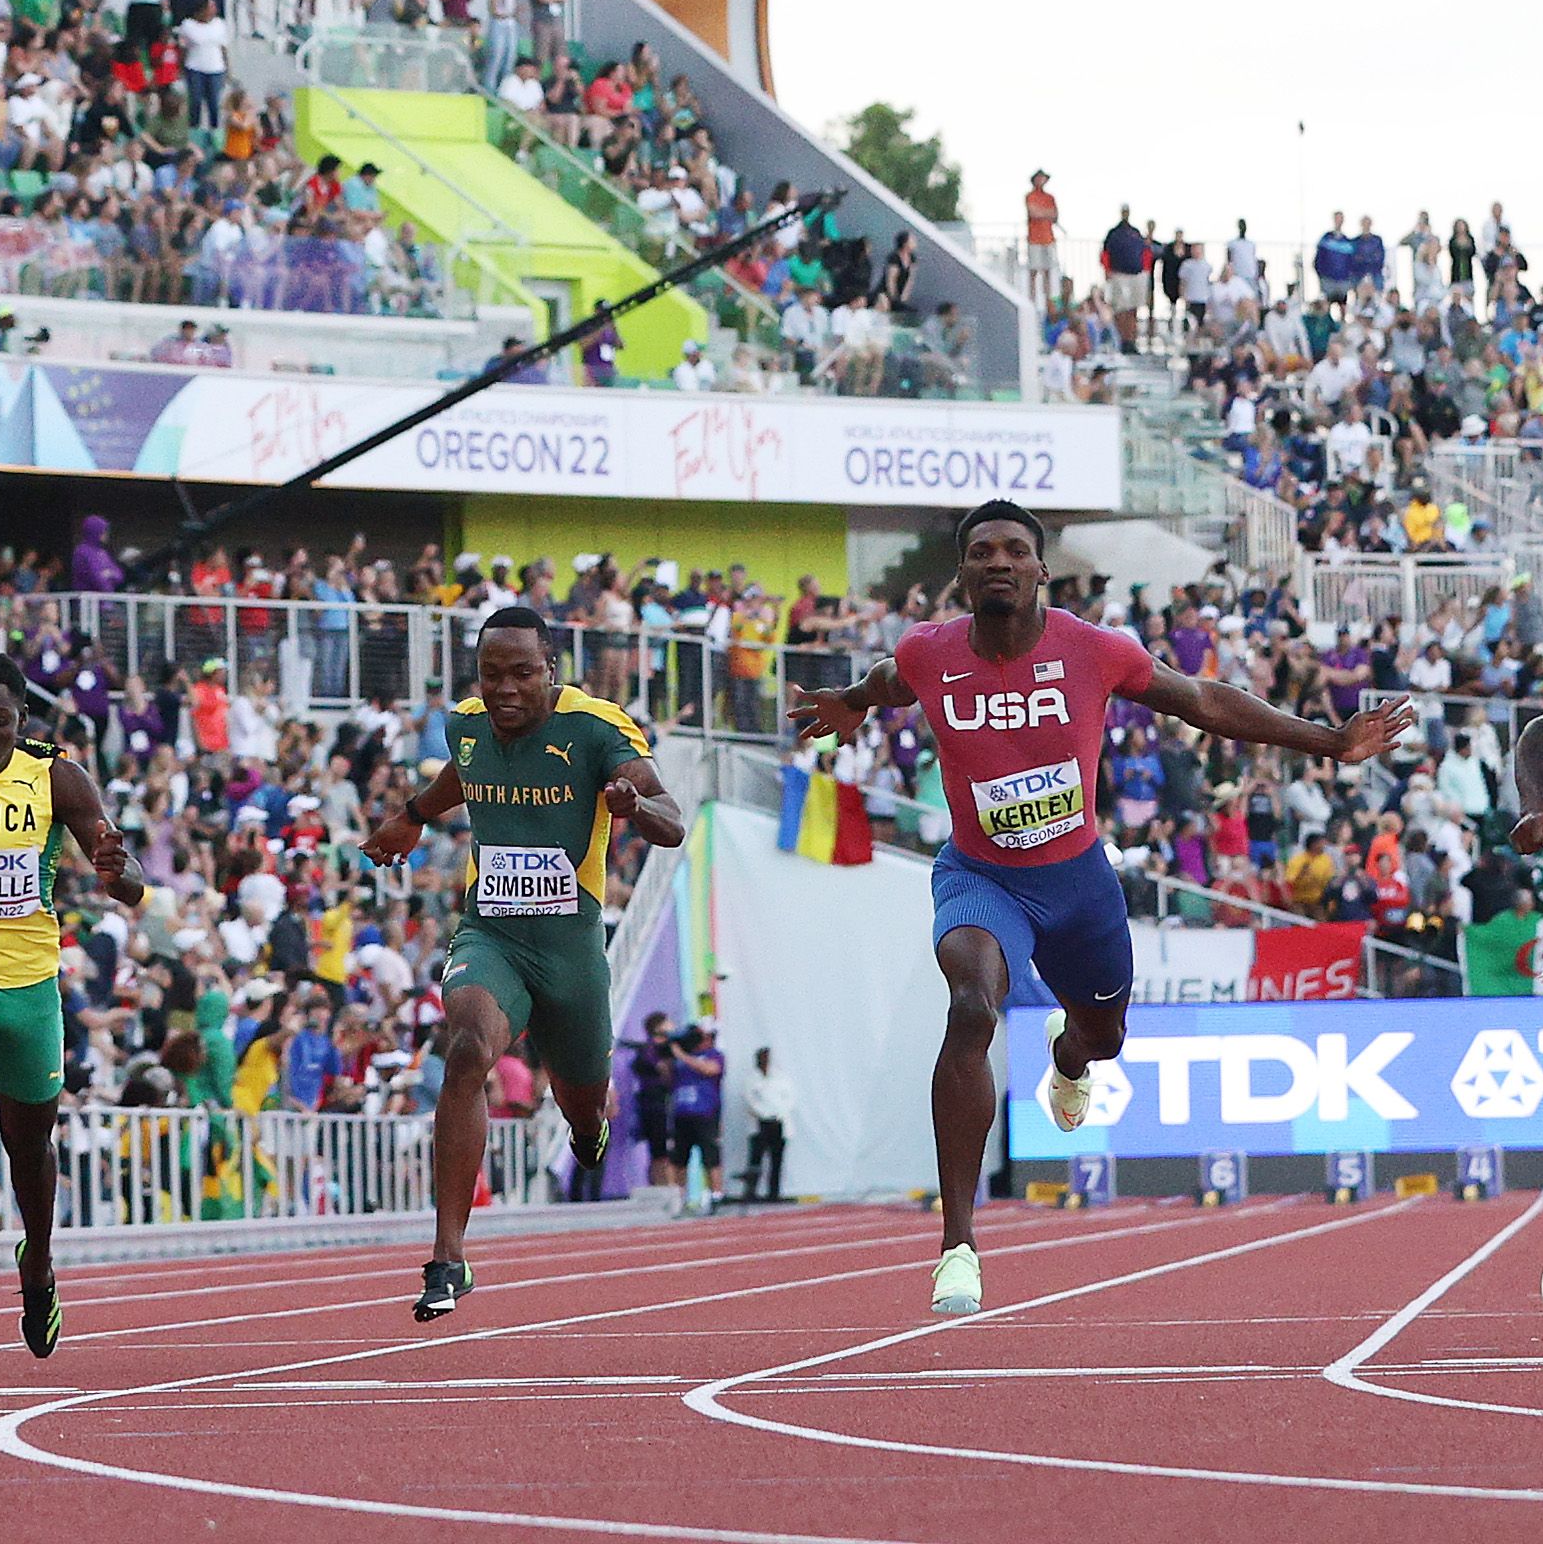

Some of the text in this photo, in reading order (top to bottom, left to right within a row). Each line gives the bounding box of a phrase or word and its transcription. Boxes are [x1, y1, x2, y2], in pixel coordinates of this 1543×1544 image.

[943, 688, 1071, 730] USA
[511, 784, 574, 806] AFRICA
[1005, 767, 1067, 797] TDK
[989, 789, 1076, 832] KERLEY
[506, 852, 562, 870] TDK
[483, 874, 572, 897] SIMBINE
[1123, 1032, 1419, 1124] TDK
[1078, 1161, 1104, 1190] 7
[1209, 1157, 1235, 1188] 6
[1337, 1156, 1363, 1186] 5
[1467, 1155, 1491, 1181] 4
